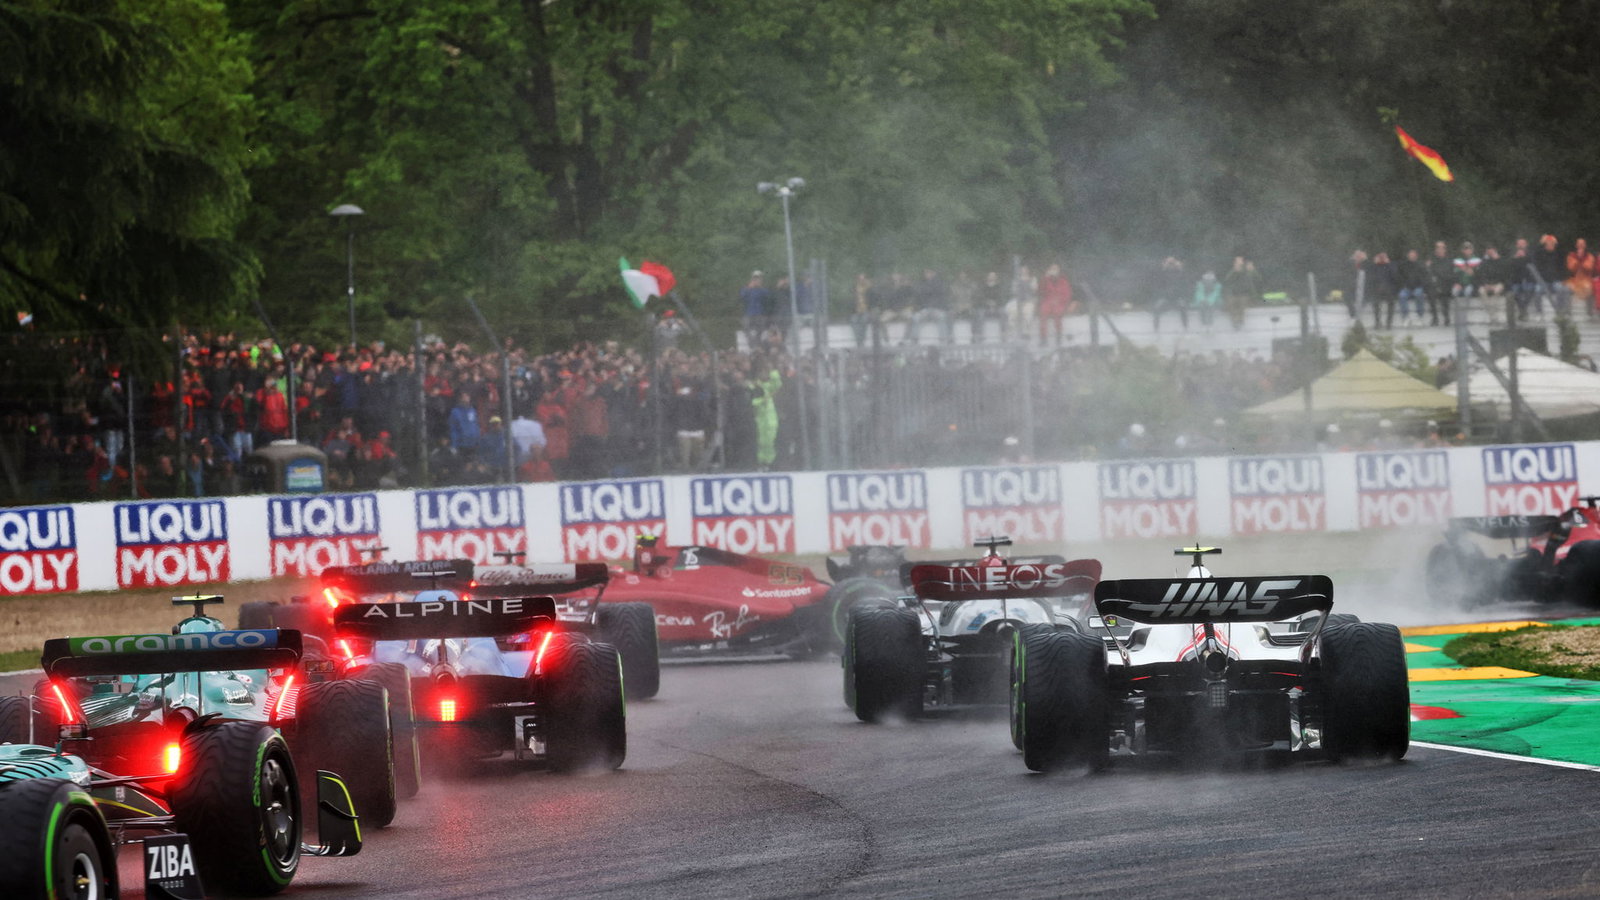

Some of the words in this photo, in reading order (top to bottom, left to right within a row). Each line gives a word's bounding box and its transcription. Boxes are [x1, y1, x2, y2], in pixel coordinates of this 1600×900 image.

[1102, 462, 1193, 499] LIQUI
[1232, 458, 1322, 494] LIQUI
[1359, 452, 1448, 489] LIQUI
[1485, 445, 1575, 482] LIQUI
[564, 482, 660, 521] LIQUI
[694, 478, 790, 515] LIQUI
[830, 474, 923, 511] LIQUI
[965, 469, 1058, 505] LIQUI
[1488, 484, 1577, 516] MOLY
[119, 502, 223, 543] LIQUI
[272, 497, 374, 536] LIQUI
[420, 489, 520, 528] LIQUI
[967, 507, 1061, 542] MOLY
[1103, 501, 1194, 538] MOLY
[1234, 498, 1324, 532] MOLY
[1361, 491, 1449, 527] MOLY
[0, 511, 71, 550] QUI
[422, 529, 525, 566] MOLY
[696, 519, 792, 552] MOLY
[833, 513, 926, 548] MOLY
[0, 553, 74, 592] OLY
[119, 545, 226, 587] MOLY
[948, 564, 1065, 592] INEOS
[364, 600, 523, 618] ALPINE
[755, 586, 811, 598] Santander
[1128, 580, 1302, 617] HAAS
[81, 631, 267, 653] aramco
[148, 844, 195, 879] ZIBA
